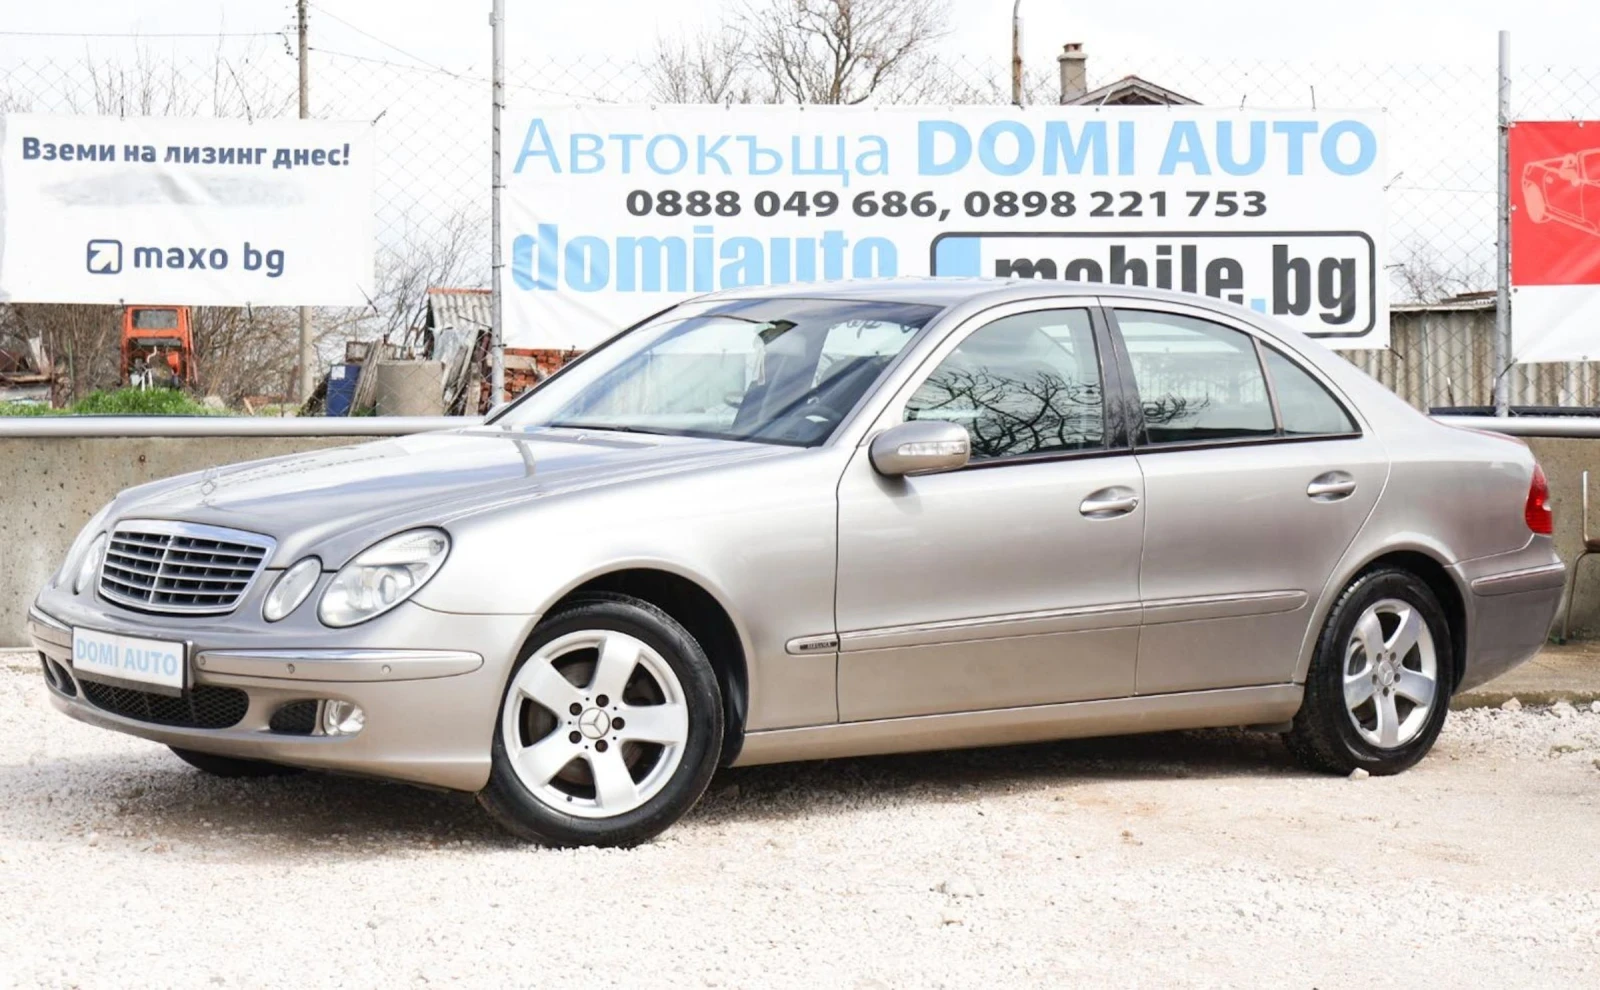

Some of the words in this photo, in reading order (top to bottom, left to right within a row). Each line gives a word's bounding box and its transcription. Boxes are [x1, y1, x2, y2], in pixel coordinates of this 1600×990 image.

[23, 137, 114, 161] Вземи
[125, 145, 155, 162] на
[165, 147, 266, 164] лизинг
[273, 144, 349, 168] днес!
[514, 118, 889, 187] Автокъща
[918, 120, 1135, 176] DOMI
[1159, 120, 1377, 176] AUTO
[627, 190, 741, 216] 0888
[754, 191, 838, 217] 049
[853, 191, 950, 221] 686,
[965, 191, 1076, 217] 0898
[1090, 191, 1165, 217] 221
[1186, 191, 1266, 217] 753
[134, 247, 228, 269] maxo
[244, 242, 284, 277] bg
[512, 223, 898, 289] domiauto
[76, 638, 118, 667] DOMI
[124, 648, 178, 676] AUTO
